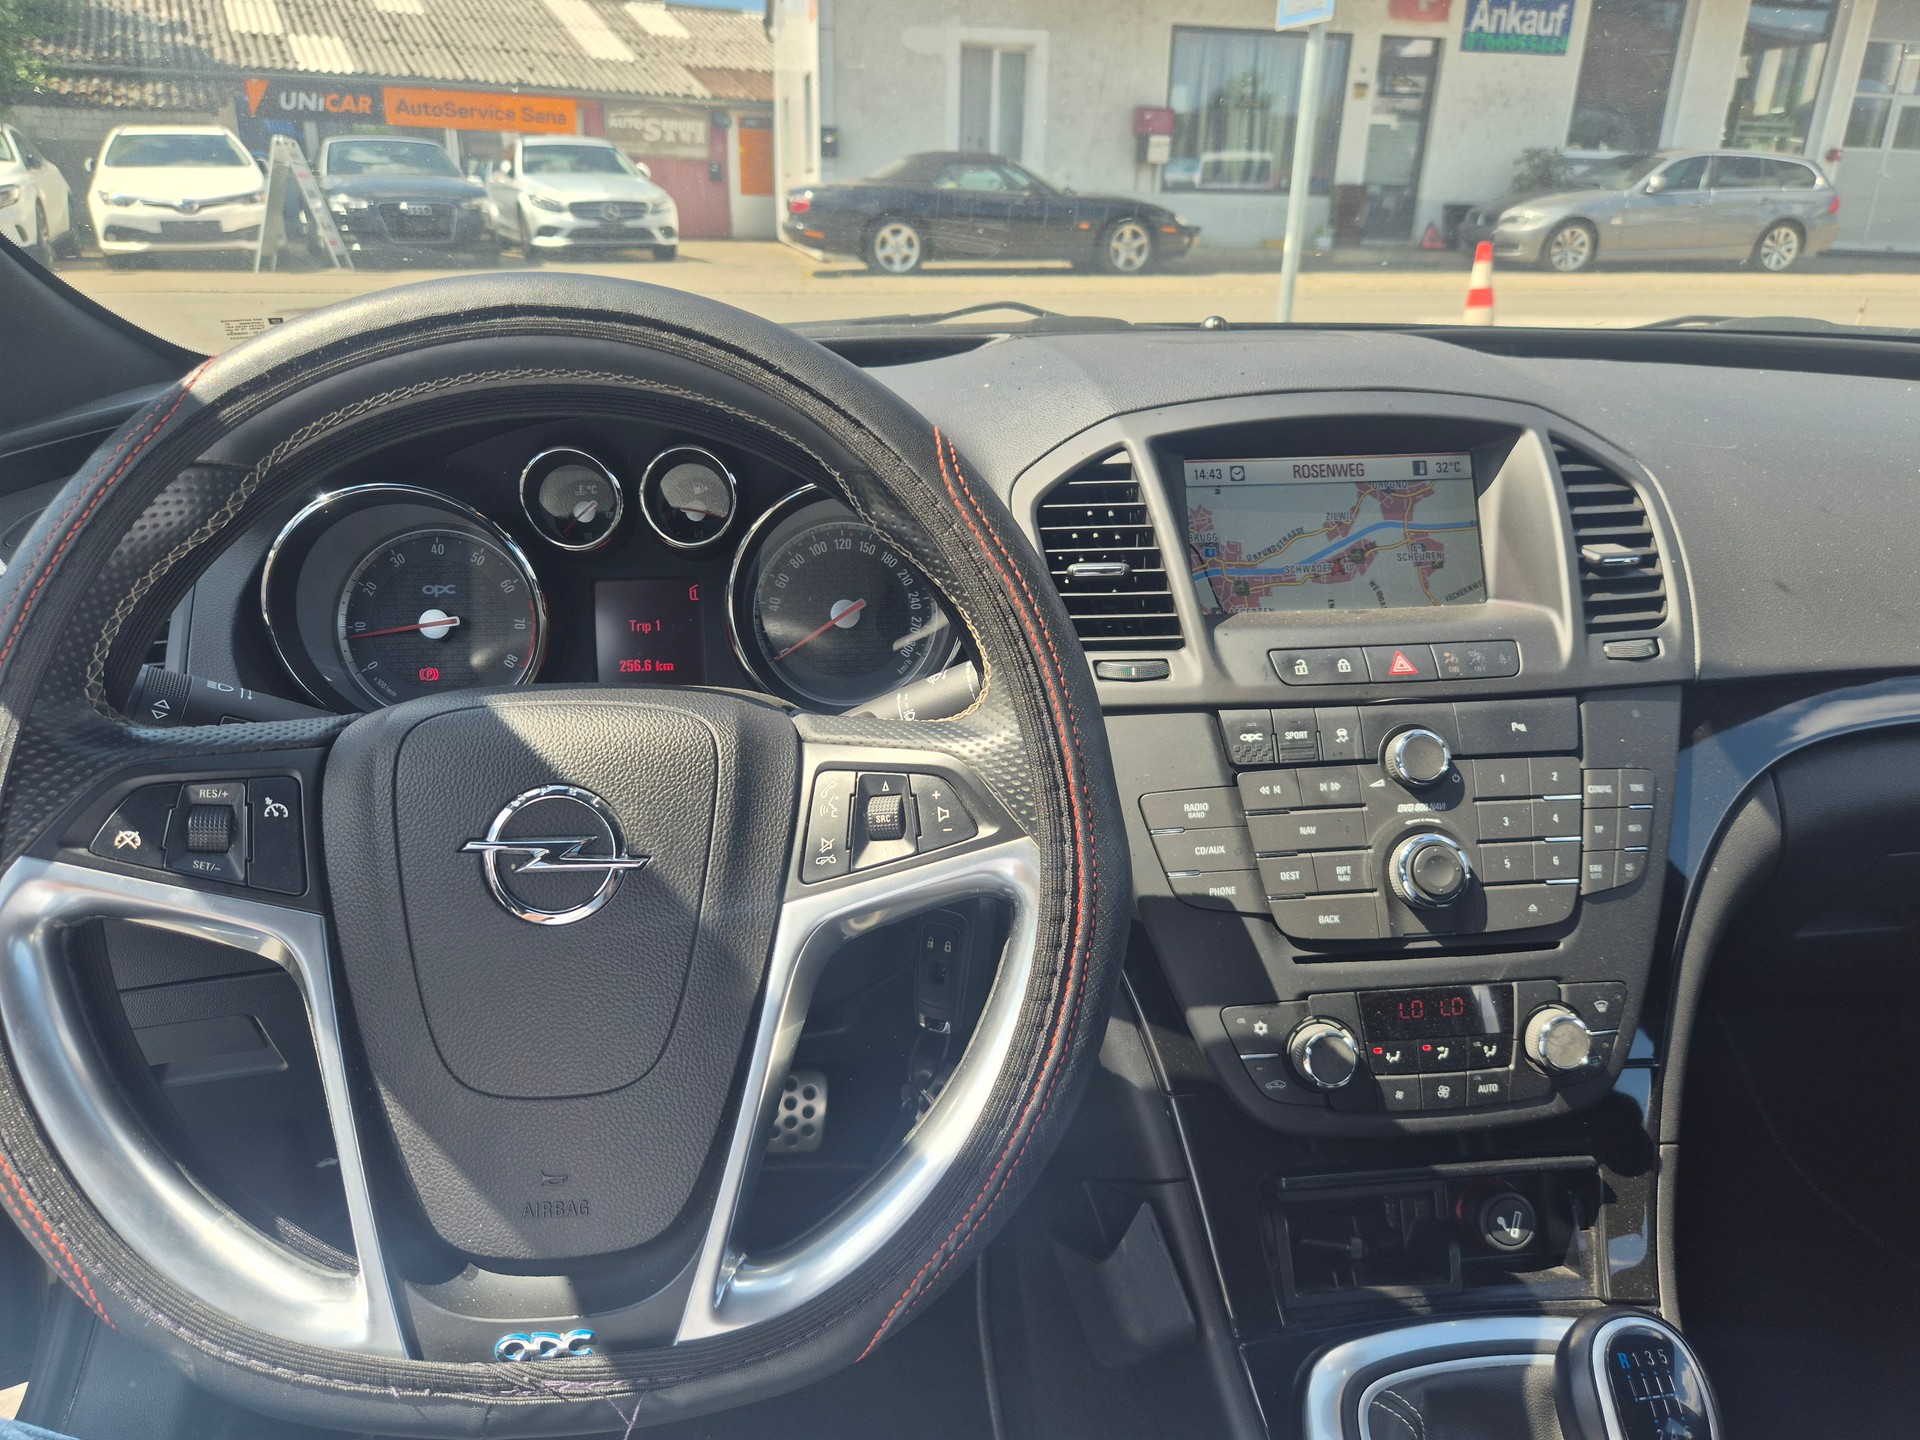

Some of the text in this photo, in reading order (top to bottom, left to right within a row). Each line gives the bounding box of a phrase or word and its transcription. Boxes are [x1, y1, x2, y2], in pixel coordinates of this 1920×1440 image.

[1470, 0, 1568, 36] Ankauf
[396, 99, 567, 125] AutoService Sana
[1292, 462, 1365, 479] ROSENWEG
[1435, 461, 1461, 474] 32°C
[1193, 468, 1223, 480] 14:43
[430, 544, 445, 555] 40
[809, 541, 828, 556] 100
[835, 538, 852, 550] 120
[859, 541, 876, 556] 150
[390, 553, 406, 568] 30
[469, 552, 485, 566] 50
[789, 553, 805, 569] 80
[881, 551, 898, 568] 180
[775, 573, 789, 589] 60
[897, 569, 914, 586] 210
[362, 581, 377, 596] 20
[500, 579, 515, 593] 60
[769, 597, 781, 612] 40
[908, 591, 921, 610] 240
[354, 621, 366, 632] 10
[514, 617, 526, 629] 70
[629, 619, 662, 634] Trip 1
[909, 616, 922, 633] 270
[367, 661, 378, 670] 0
[503, 653, 518, 668] 80
[619, 660, 674, 672] 256.6 km
[896, 659, 912, 675] km/h
[1240, 733, 1263, 742] opc
[1284, 730, 1308, 740] SPORT
[1499, 773, 1505, 783] 1
[1551, 771, 1558, 781] 2
[1183, 802, 1209, 812] RADIO
[1397, 803, 1415, 813] DVD
[875, 814, 891, 823] SRC
[1187, 811, 1205, 819] BAND
[1552, 813, 1559, 823] 4
[1502, 816, 1509, 827] 3
[1299, 826, 1317, 835] NAV
[1194, 845, 1226, 855] CD/AUX
[1504, 859, 1510, 869] 5
[1552, 856, 1559, 866] 6
[1280, 870, 1300, 881] DEST
[1336, 865, 1351, 875] RPT
[1209, 886, 1237, 897] PHONE
[1318, 914, 1340, 925] BACK
[1477, 1083, 1498, 1094] AUTO
[522, 1200, 590, 1219] AIRBAG
[1617, 1348, 1668, 1369] R 1 3 5
